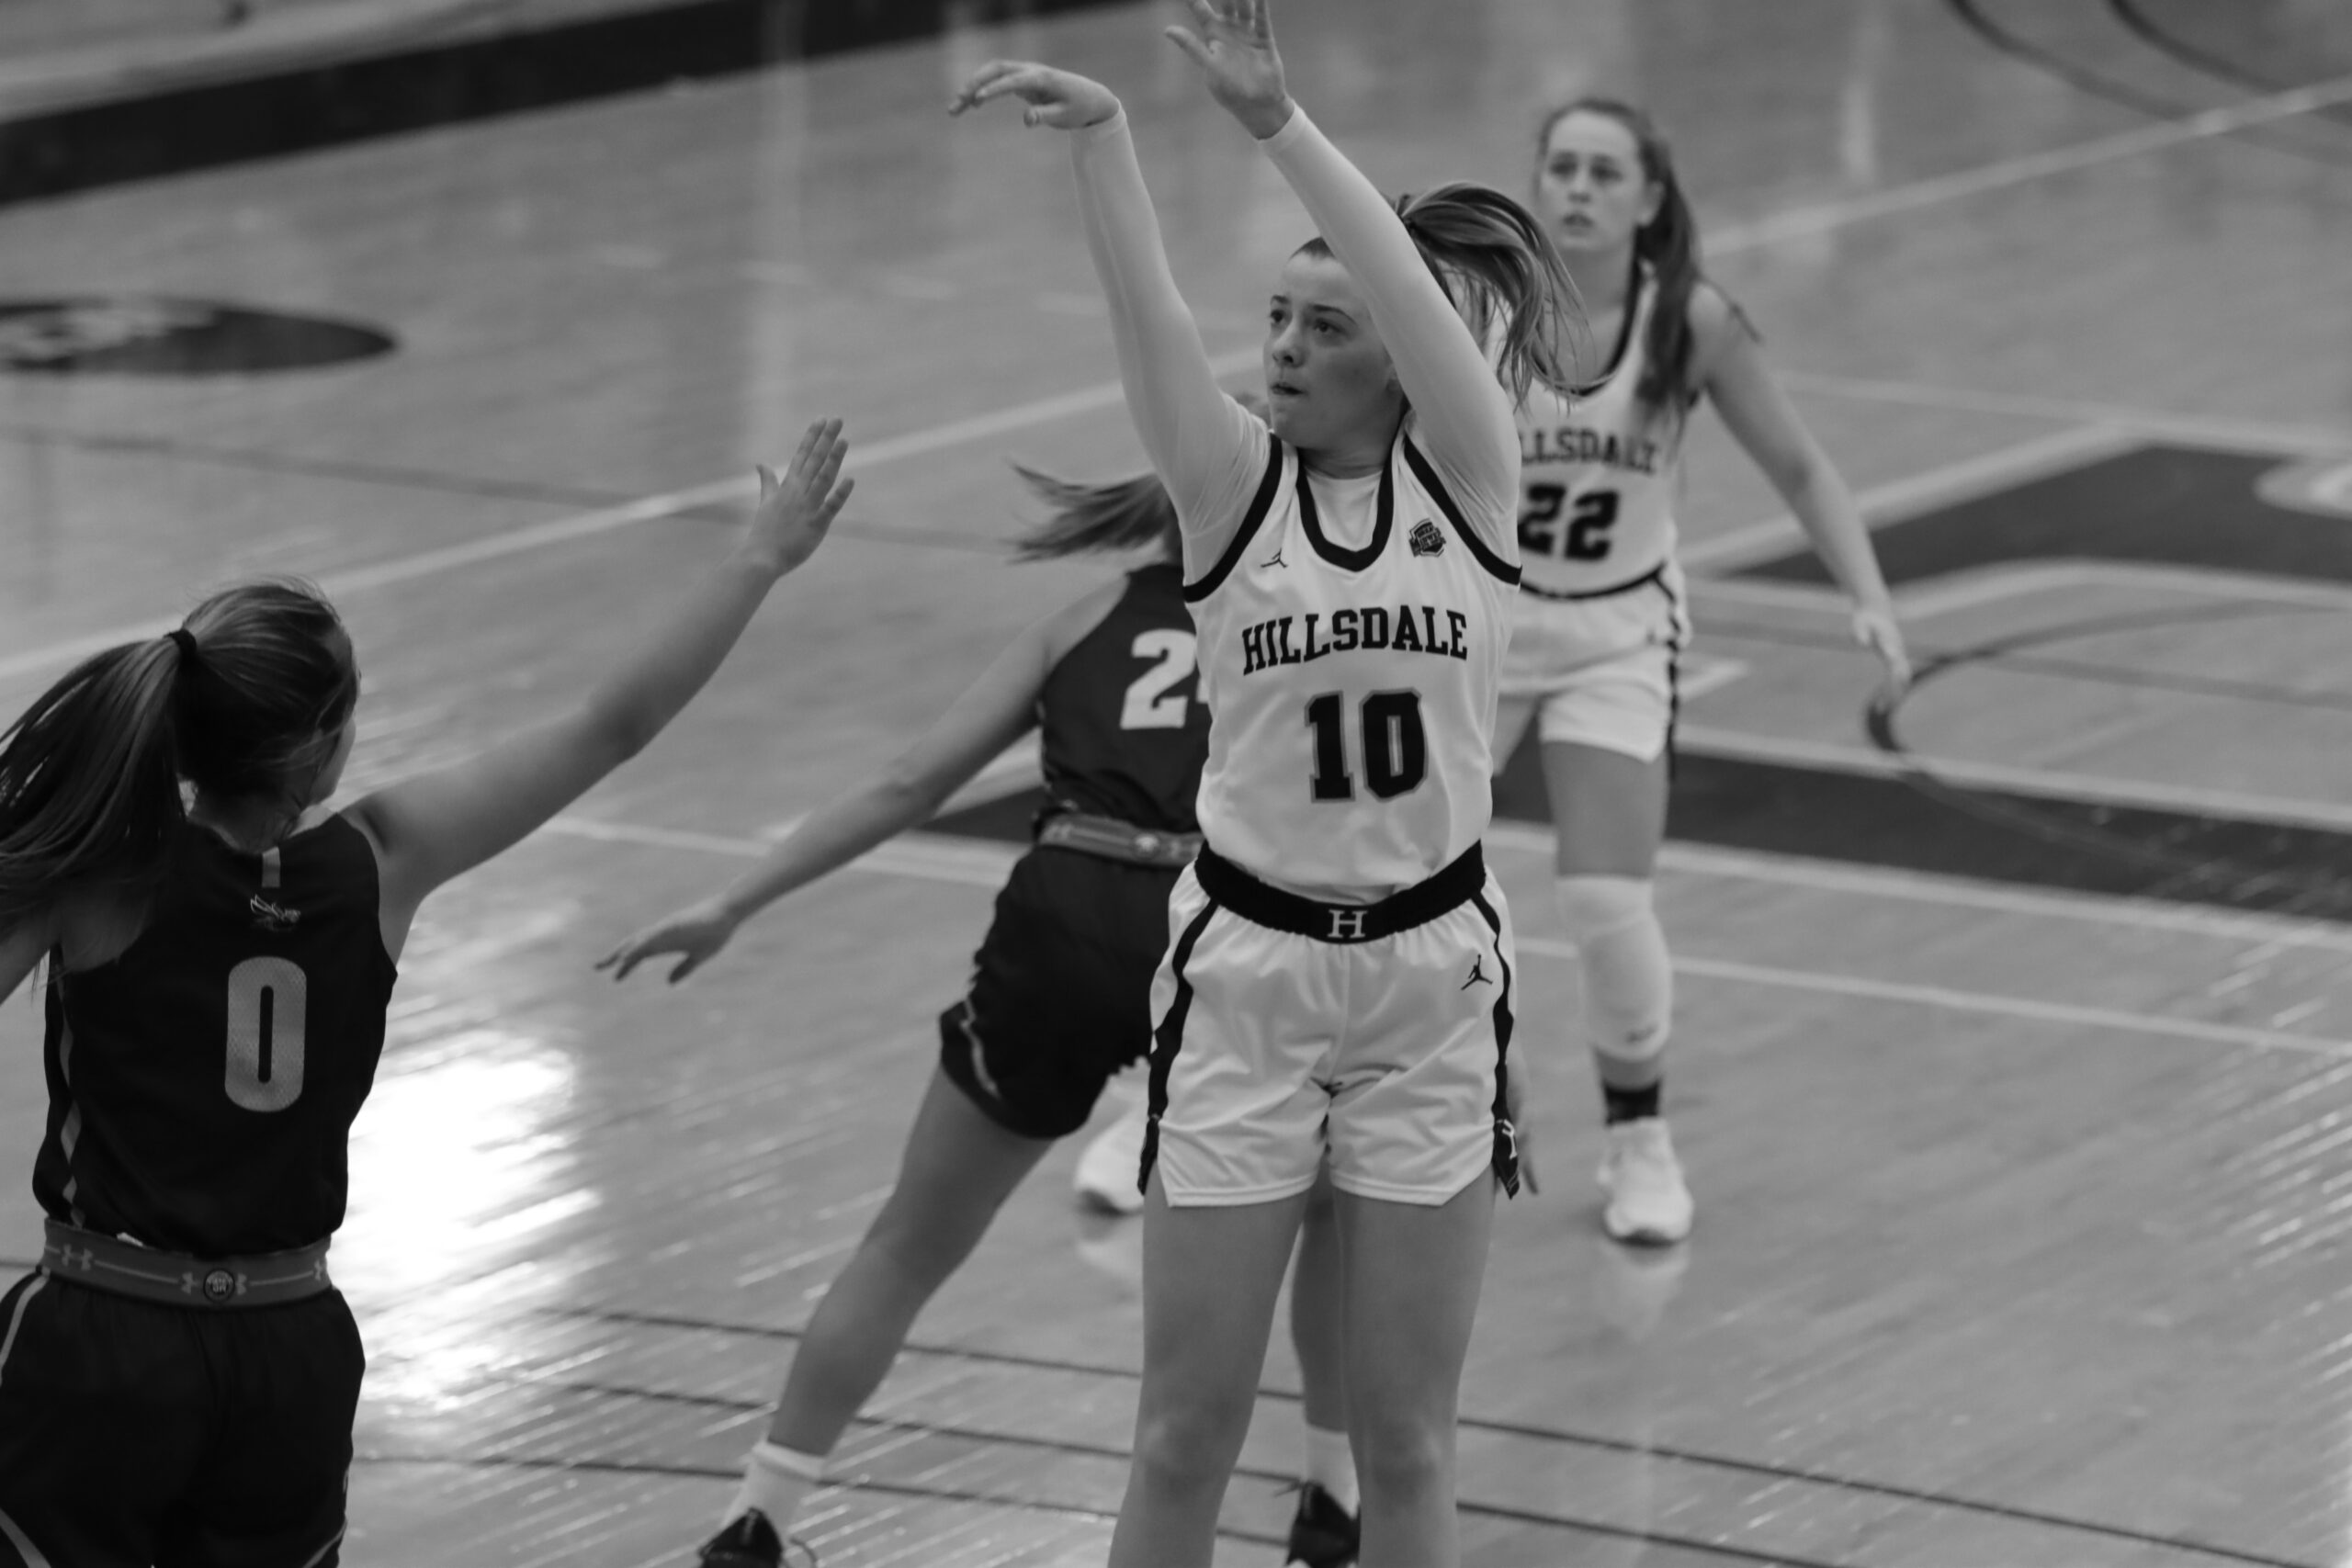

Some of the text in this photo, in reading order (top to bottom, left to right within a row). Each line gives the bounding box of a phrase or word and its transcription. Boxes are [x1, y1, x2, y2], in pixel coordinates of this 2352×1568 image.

[1517, 483, 1619, 562] 22
[1120, 628, 1208, 729] 2
[1242, 604, 1467, 676] HILLSDALE
[1304, 688, 1429, 804] 10
[1328, 909, 1368, 939] H
[225, 956, 307, 1112] 0
